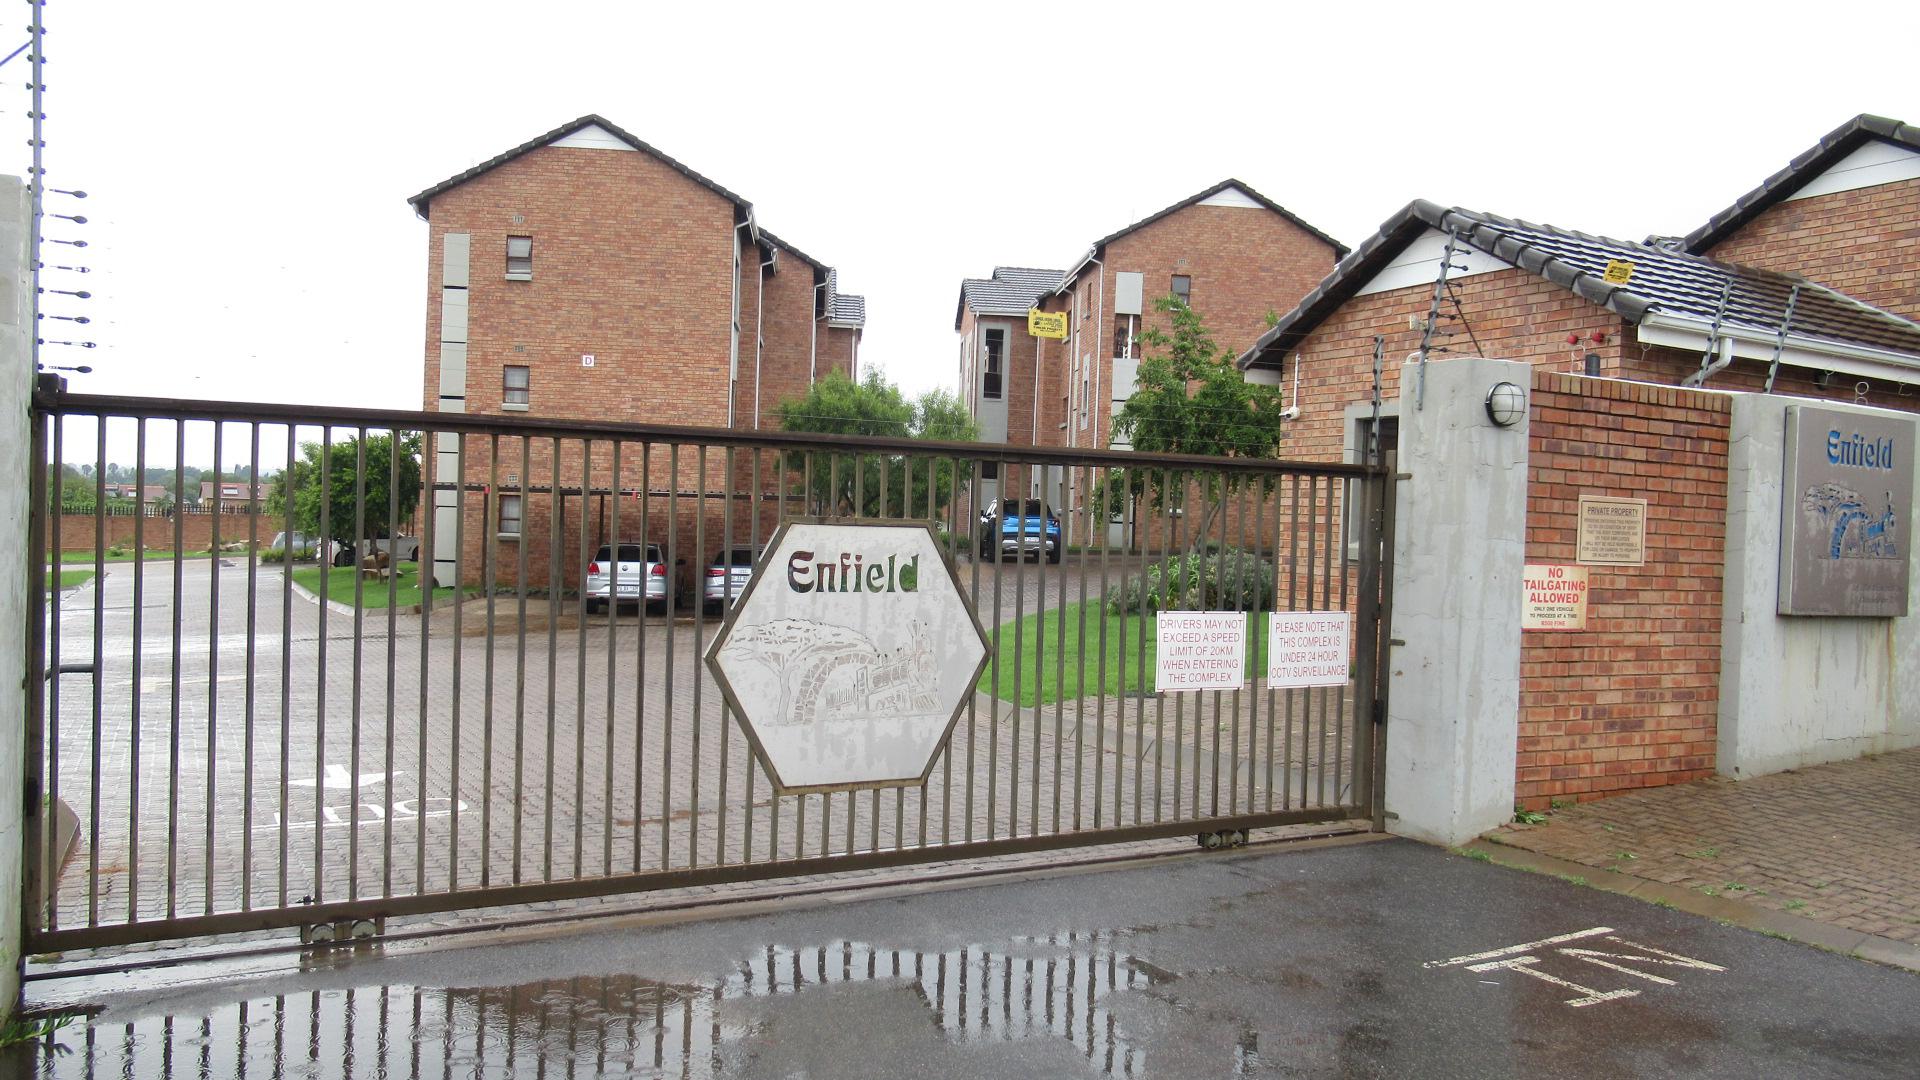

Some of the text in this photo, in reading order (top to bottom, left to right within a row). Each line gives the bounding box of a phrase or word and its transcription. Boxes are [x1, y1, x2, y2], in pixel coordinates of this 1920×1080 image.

[1827, 430, 1893, 468] Enfield
[1587, 506, 1638, 517] PRIVATE PROPERTY
[788, 550, 920, 593] Enfield
[1548, 568, 1563, 578] NO
[1524, 579, 1586, 591] TAILGATING
[1530, 593, 1579, 603] ALLOWED
[1161, 619, 1243, 629] DRIVERS MAY NOT
[1276, 621, 1344, 633] PLEASE NOTE THAT
[1163, 632, 1240, 643] EXCEED A SPEED
[1280, 636, 1341, 648] THIS COMPLEX IS
[1170, 646, 1233, 656] LIMIT OF 20KM
[1280, 651, 1339, 663] UNDER 24 HOUR
[1162, 659, 1238, 669] WHEN ENTERING
[1272, 665, 1345, 678] CCTV SURVEILLANCE
[1168, 672, 1232, 683] THE COMPLEX
